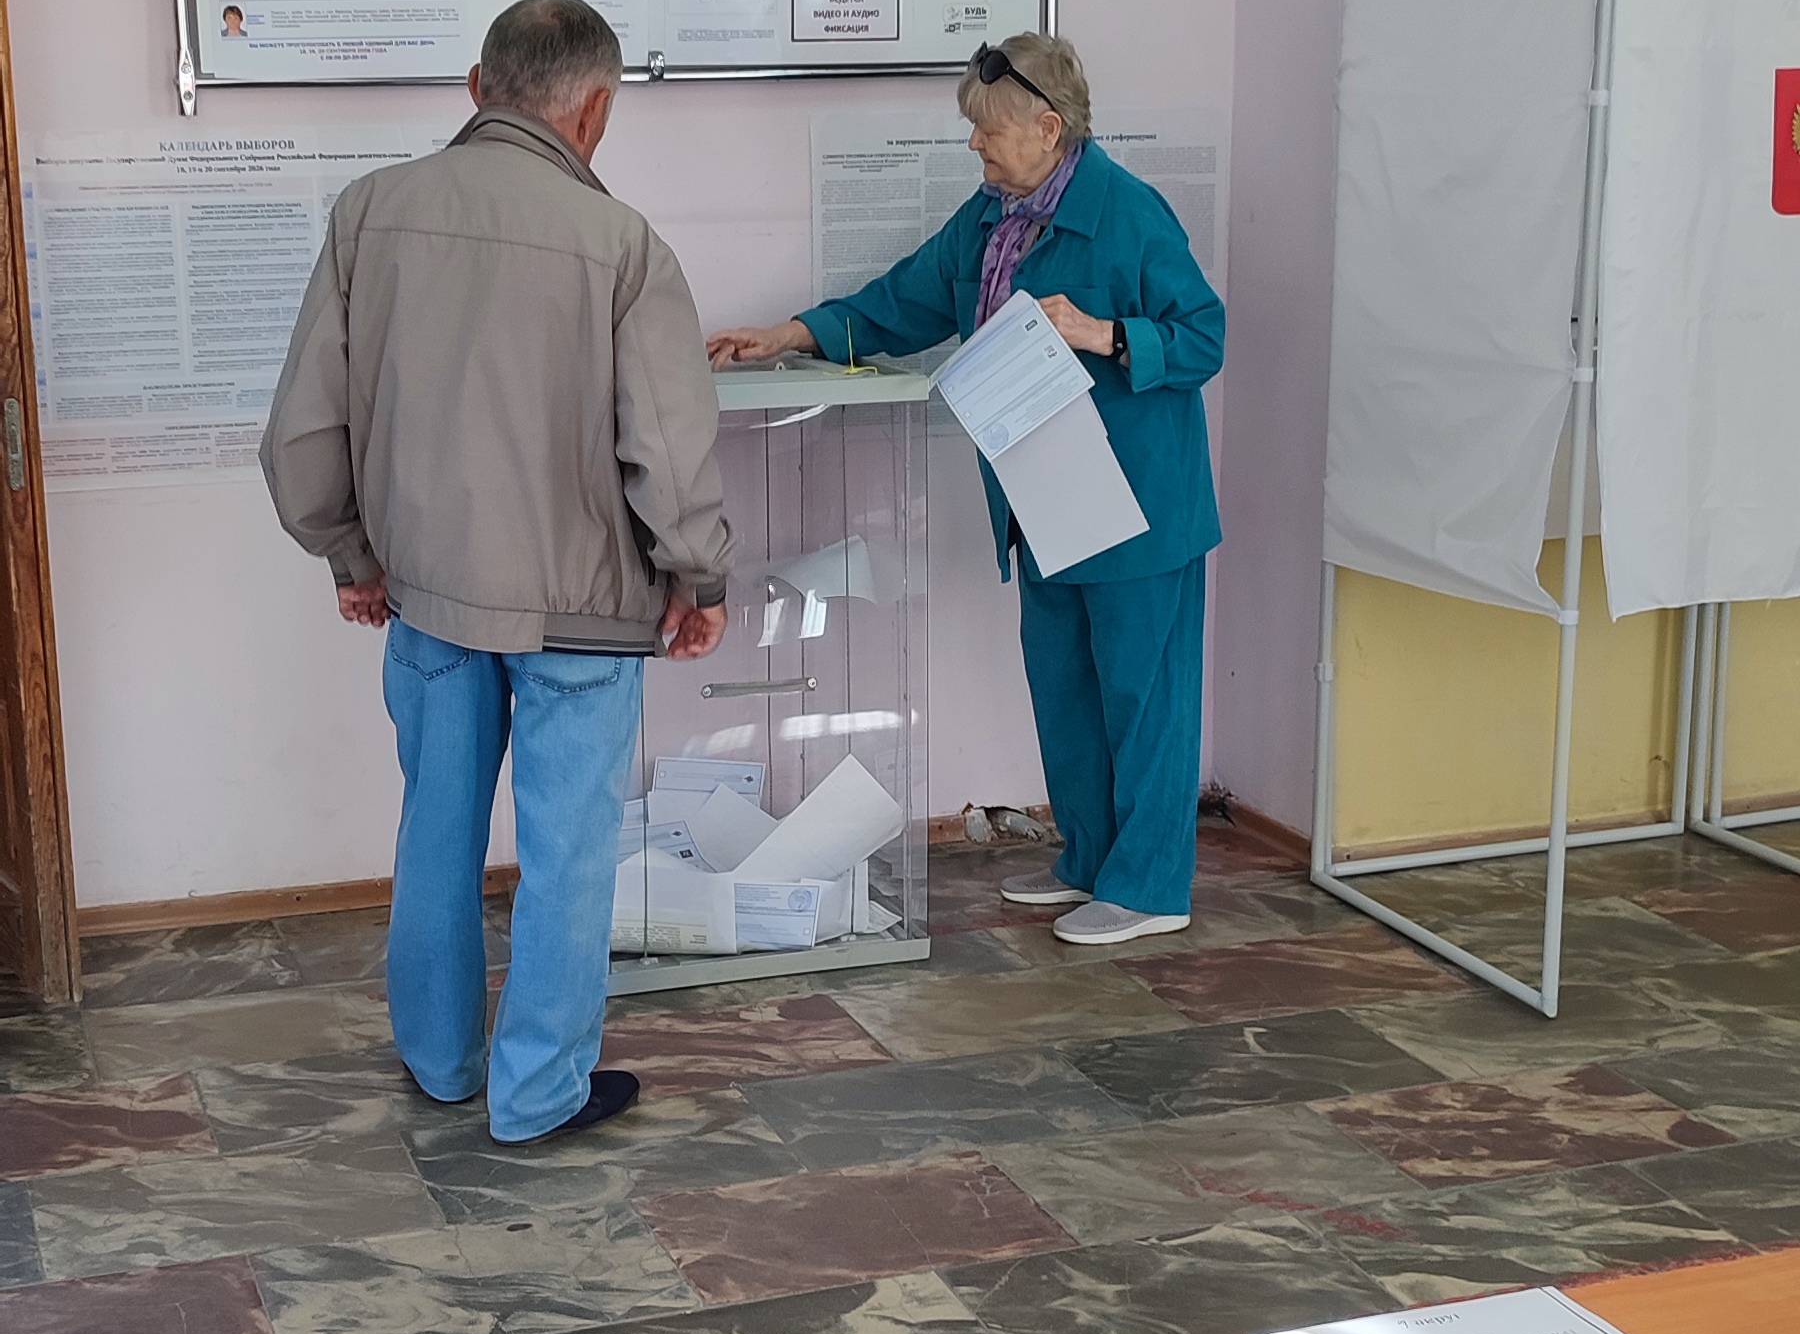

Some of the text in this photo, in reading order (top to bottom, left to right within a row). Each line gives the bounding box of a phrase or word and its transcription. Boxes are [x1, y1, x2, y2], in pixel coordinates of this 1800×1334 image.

[813, 10, 841, 19] ВИДЕО
[851, 10, 879, 19] АУДИО
[965, 7, 987, 15] БУДЬ
[824, 25, 869, 33] ФИКСАЦИЯ
[160, 140, 295, 152] КАЛЕНДАРЬ ВЫБОРОВ
